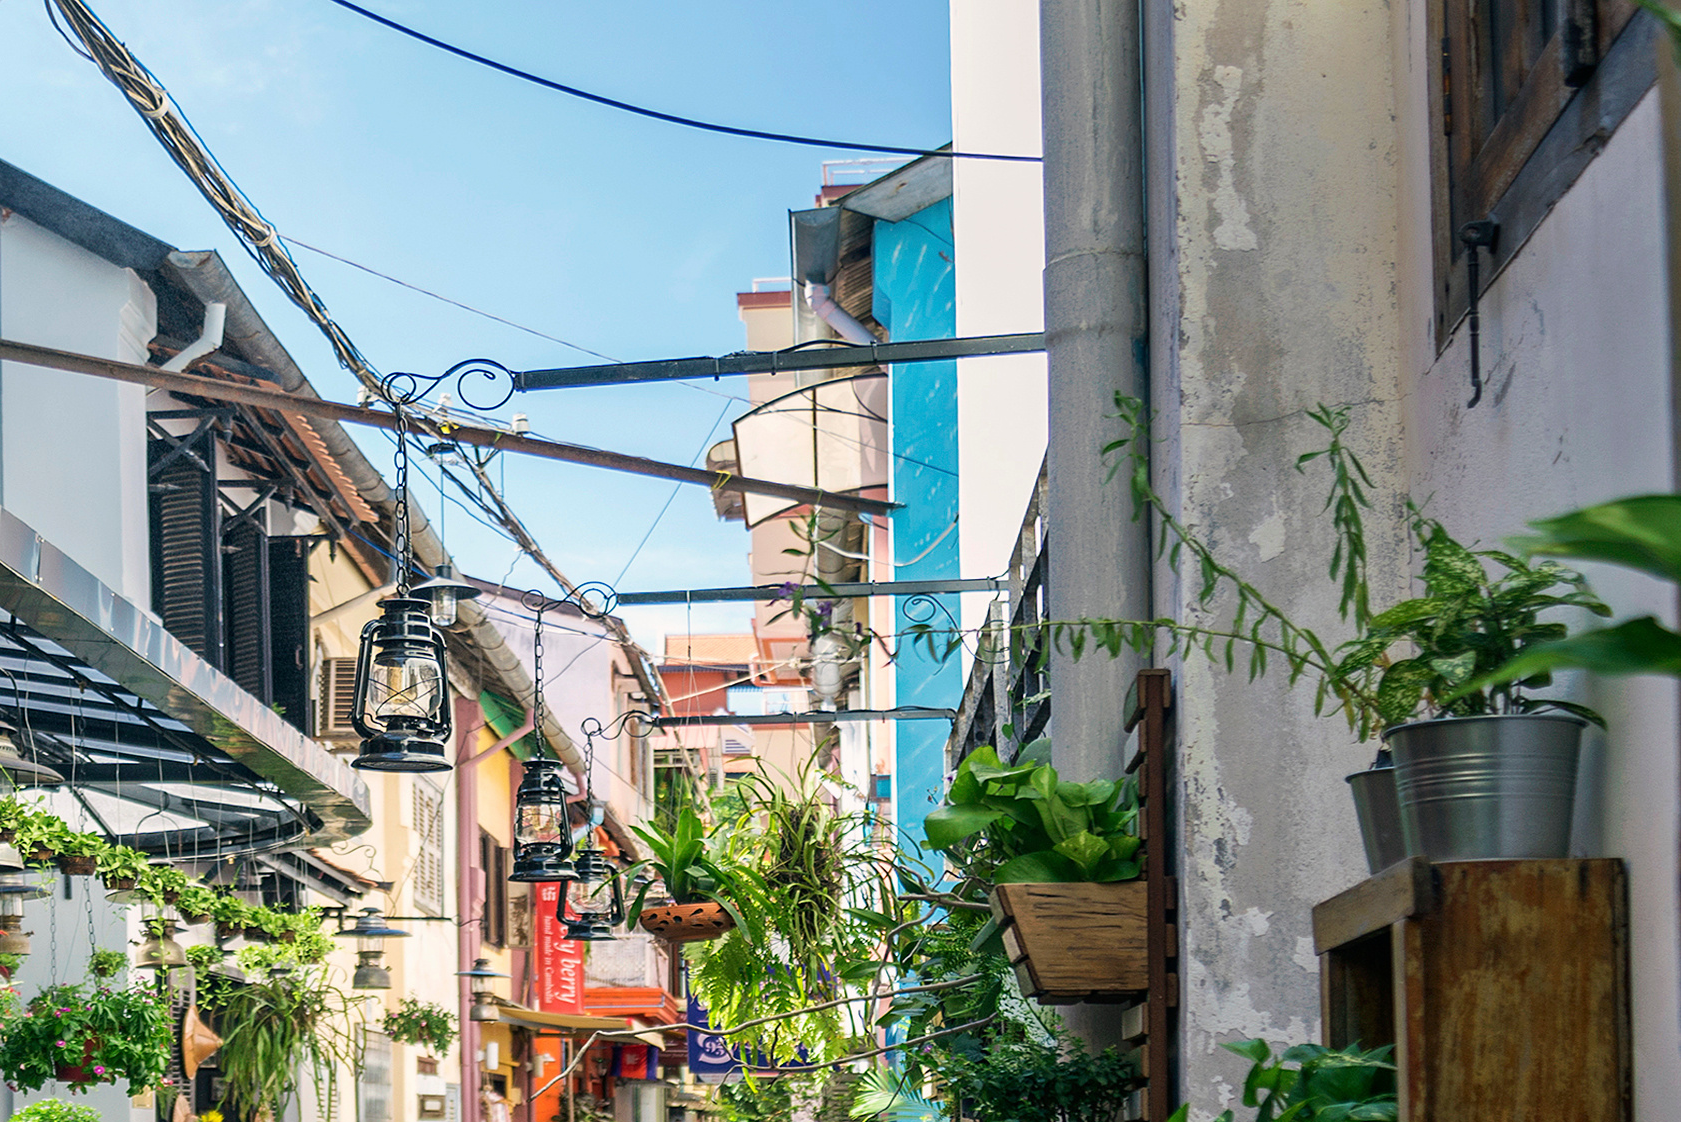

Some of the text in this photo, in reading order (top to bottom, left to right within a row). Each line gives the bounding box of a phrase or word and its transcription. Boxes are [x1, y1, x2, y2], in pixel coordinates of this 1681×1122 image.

[543, 916, 555, 1004] hand made in Cambodia
[554, 958, 582, 1004] berry
